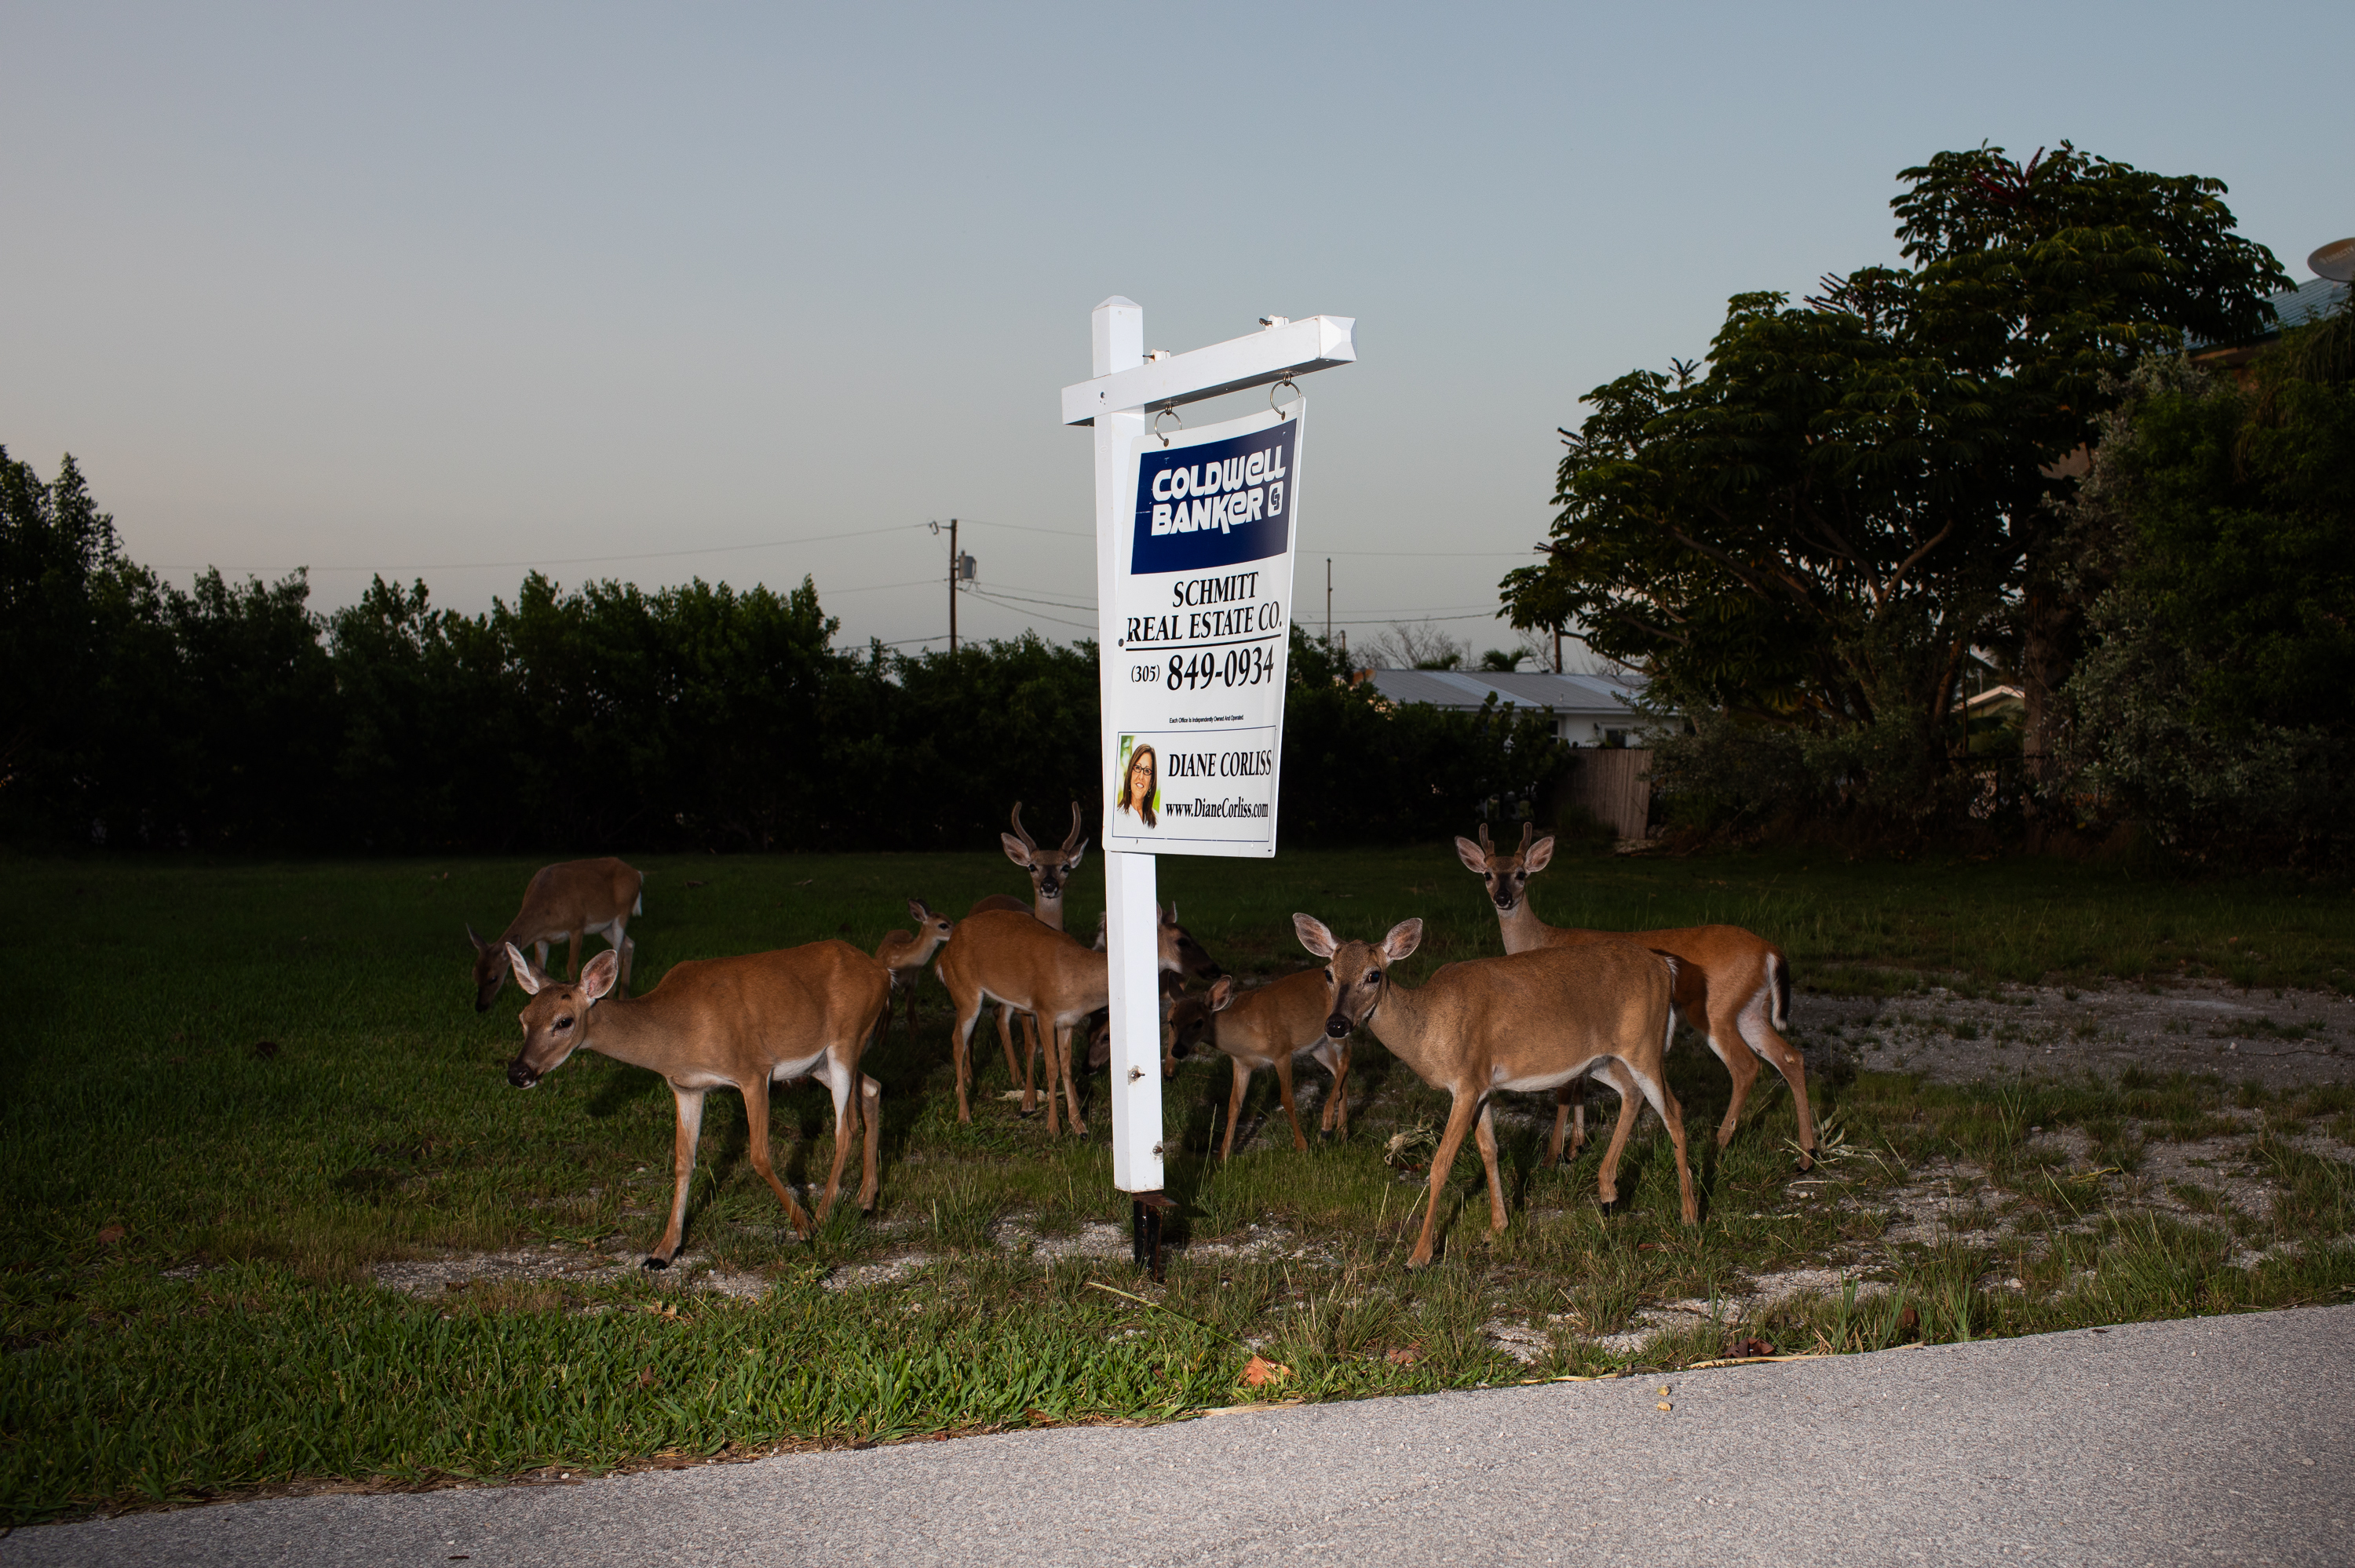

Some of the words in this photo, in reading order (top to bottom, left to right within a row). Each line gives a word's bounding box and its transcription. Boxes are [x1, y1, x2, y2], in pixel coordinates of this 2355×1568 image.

[1172, 571, 1259, 608] SCHMITT
[1126, 615, 1183, 642] REAL
[1188, 606, 1254, 639] ESTATE
[1258, 600, 1282, 631] CO.
[1131, 665, 1160, 683] (305)
[1167, 644, 1275, 691] 849-0934
[1168, 753, 1217, 777] DIANE
[1221, 749, 1272, 777] CORLISS
[1166, 797, 1269, 819] www.DianeCorliss.com
